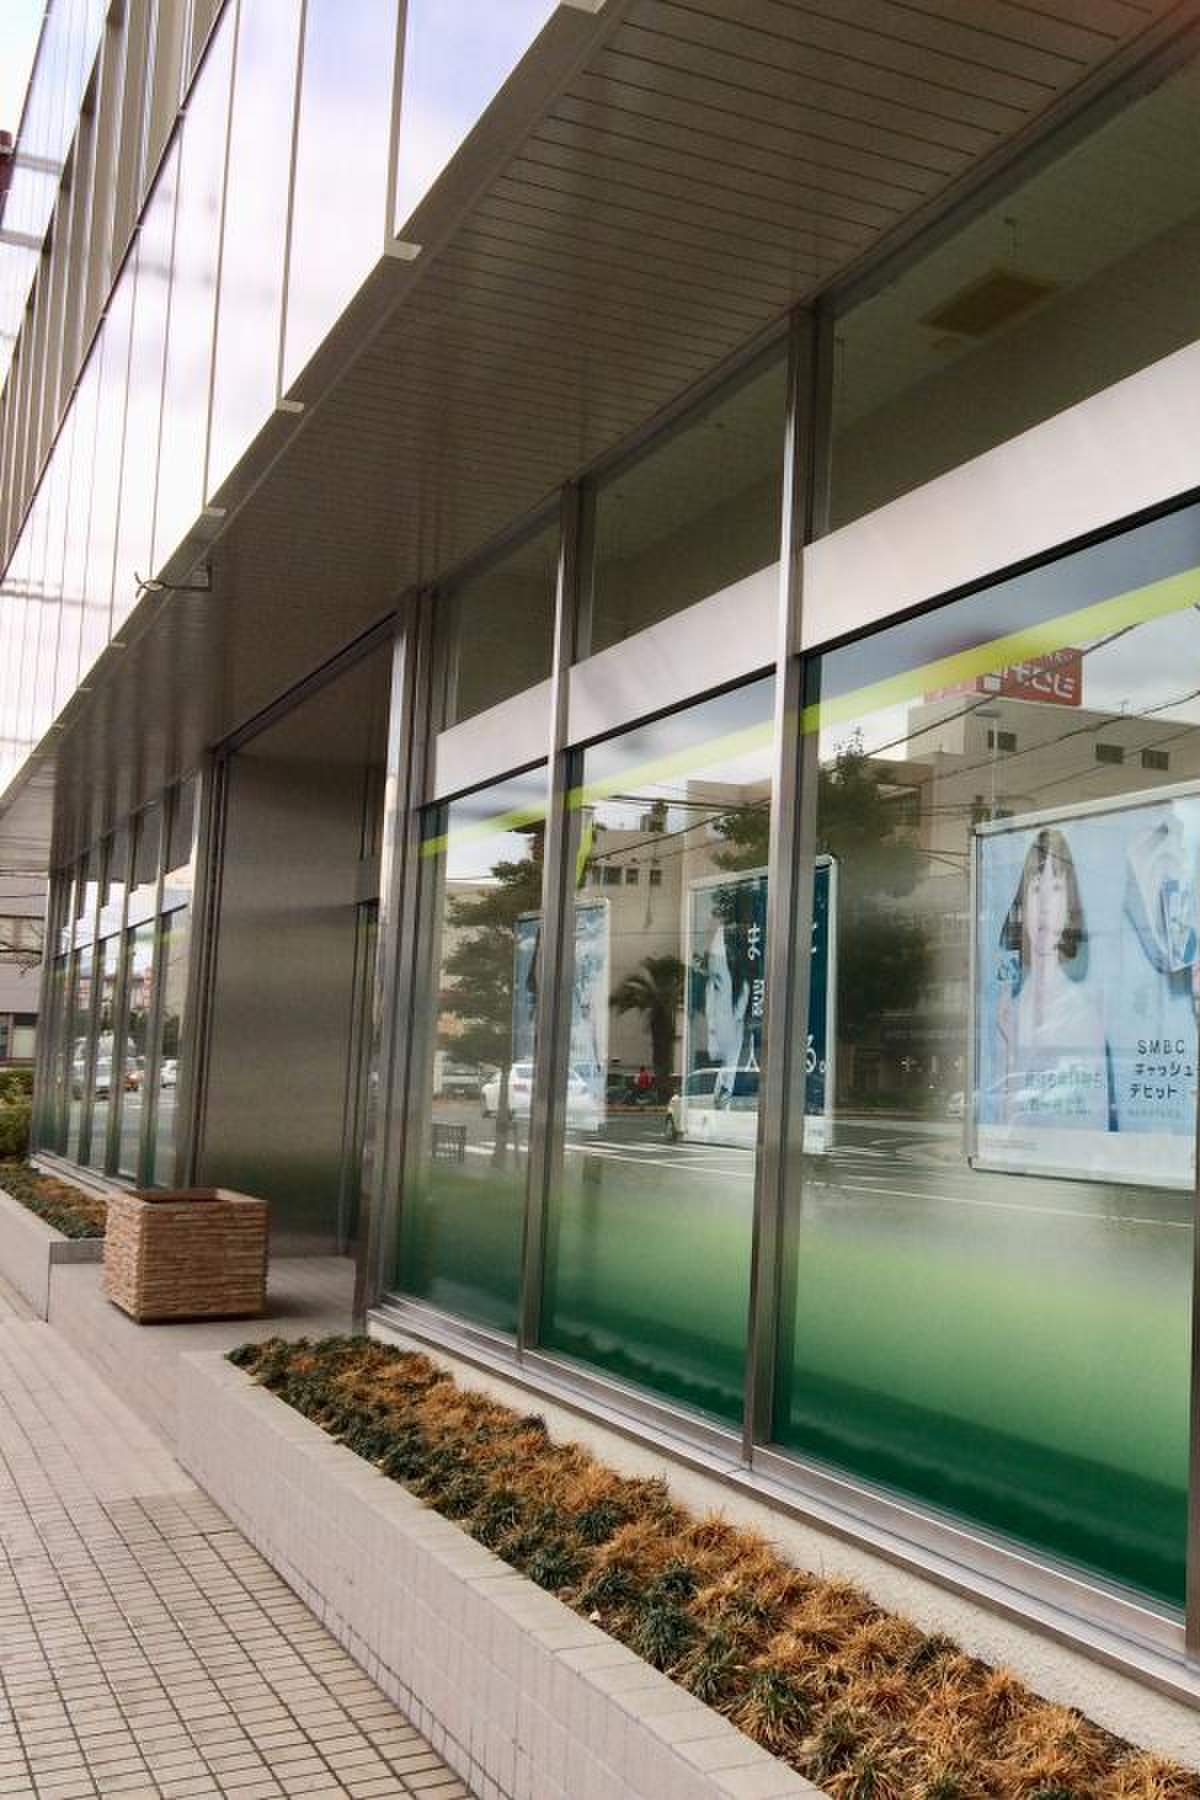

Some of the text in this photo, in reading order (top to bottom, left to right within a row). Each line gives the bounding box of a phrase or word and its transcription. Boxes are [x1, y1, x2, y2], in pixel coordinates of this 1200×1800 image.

[1136, 1039, 1185, 1055] SMBC
[1134, 1062, 1193, 1078] キャッシュ
